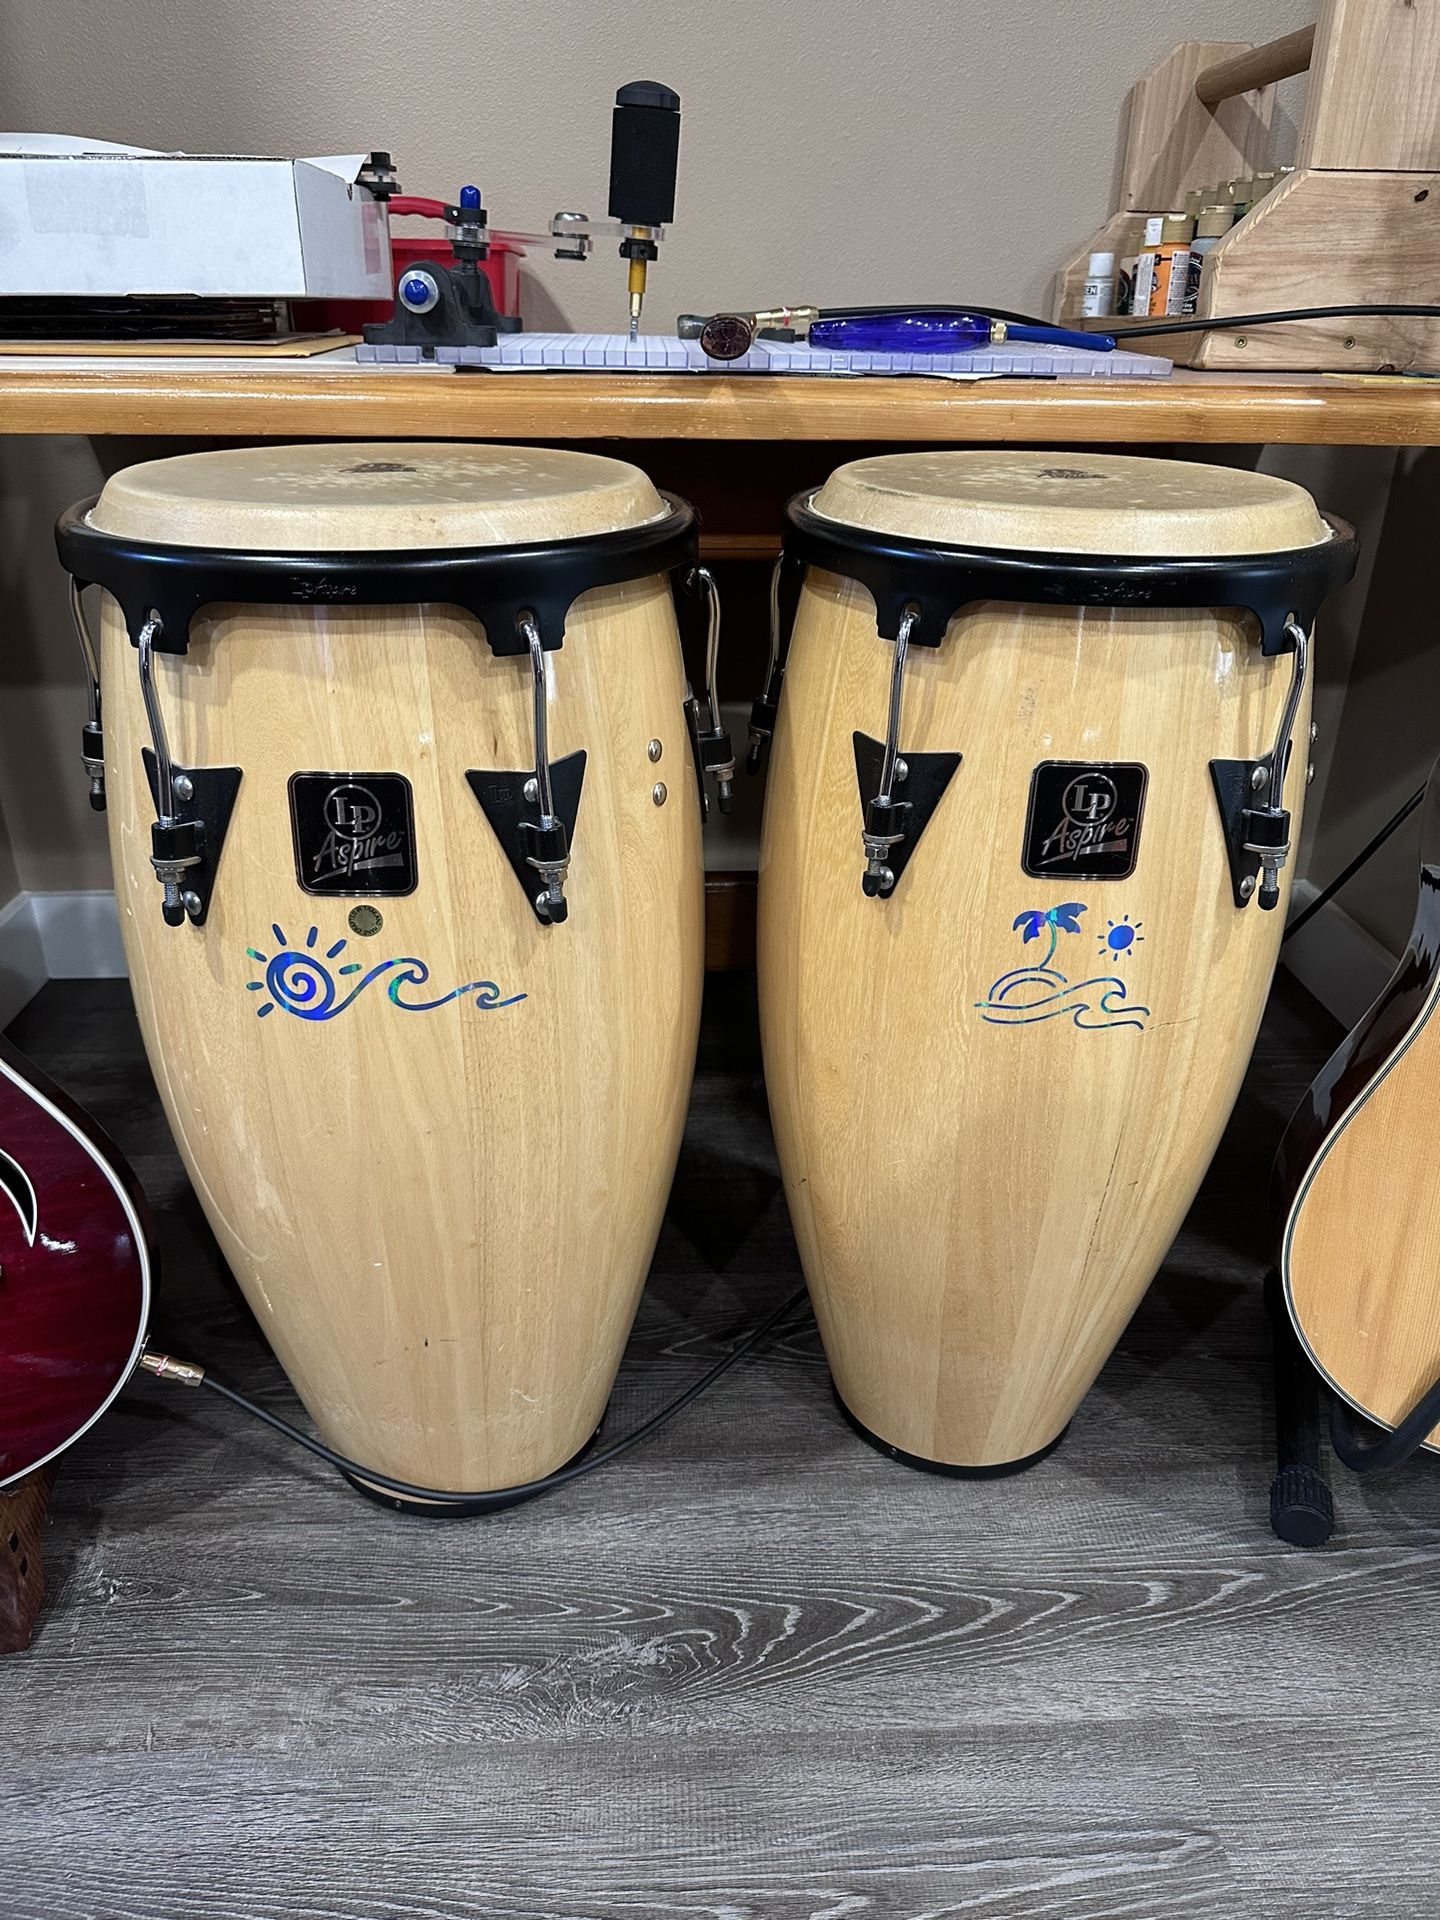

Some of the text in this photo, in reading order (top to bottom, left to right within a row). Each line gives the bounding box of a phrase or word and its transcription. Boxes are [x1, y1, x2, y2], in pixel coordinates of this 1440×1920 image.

[332, 797, 376, 833] LP
[1070, 784, 1112, 820] LP
[312, 829, 402, 877] Aspire
[1041, 816, 1131, 861] Aspire
